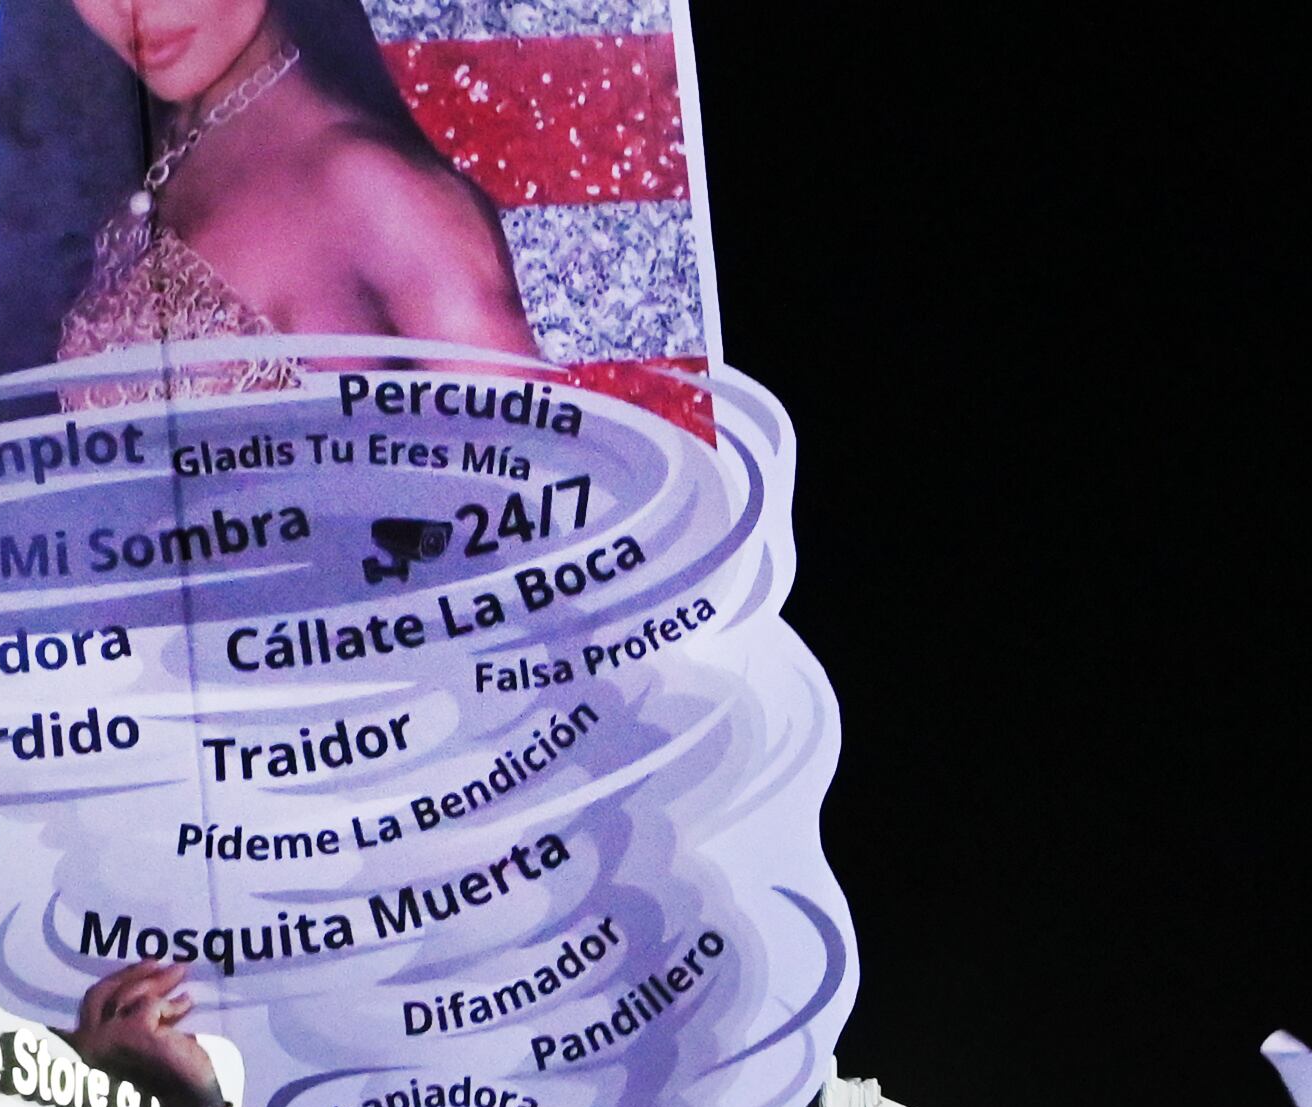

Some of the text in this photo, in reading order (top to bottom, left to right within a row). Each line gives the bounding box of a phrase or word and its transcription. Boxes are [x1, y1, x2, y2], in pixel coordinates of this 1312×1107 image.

[339, 374, 582, 438] Percudia
[172, 433, 532, 481] Gladis Tu Eres Mía
[0, 530, 69, 577] Mi
[90, 505, 310, 572] Sombra
[454, 474, 592, 557] 24/7
[225, 534, 647, 672] Cállate La Boca
[474, 596, 717, 693] Falsa Profeta
[177, 701, 600, 861] Pídeme La Bendición
[202, 712, 410, 782] Traidor
[78, 828, 571, 975] Mosquita Muerta
[402, 916, 623, 1037] Difamador
[530, 926, 726, 1071] Pandillero
